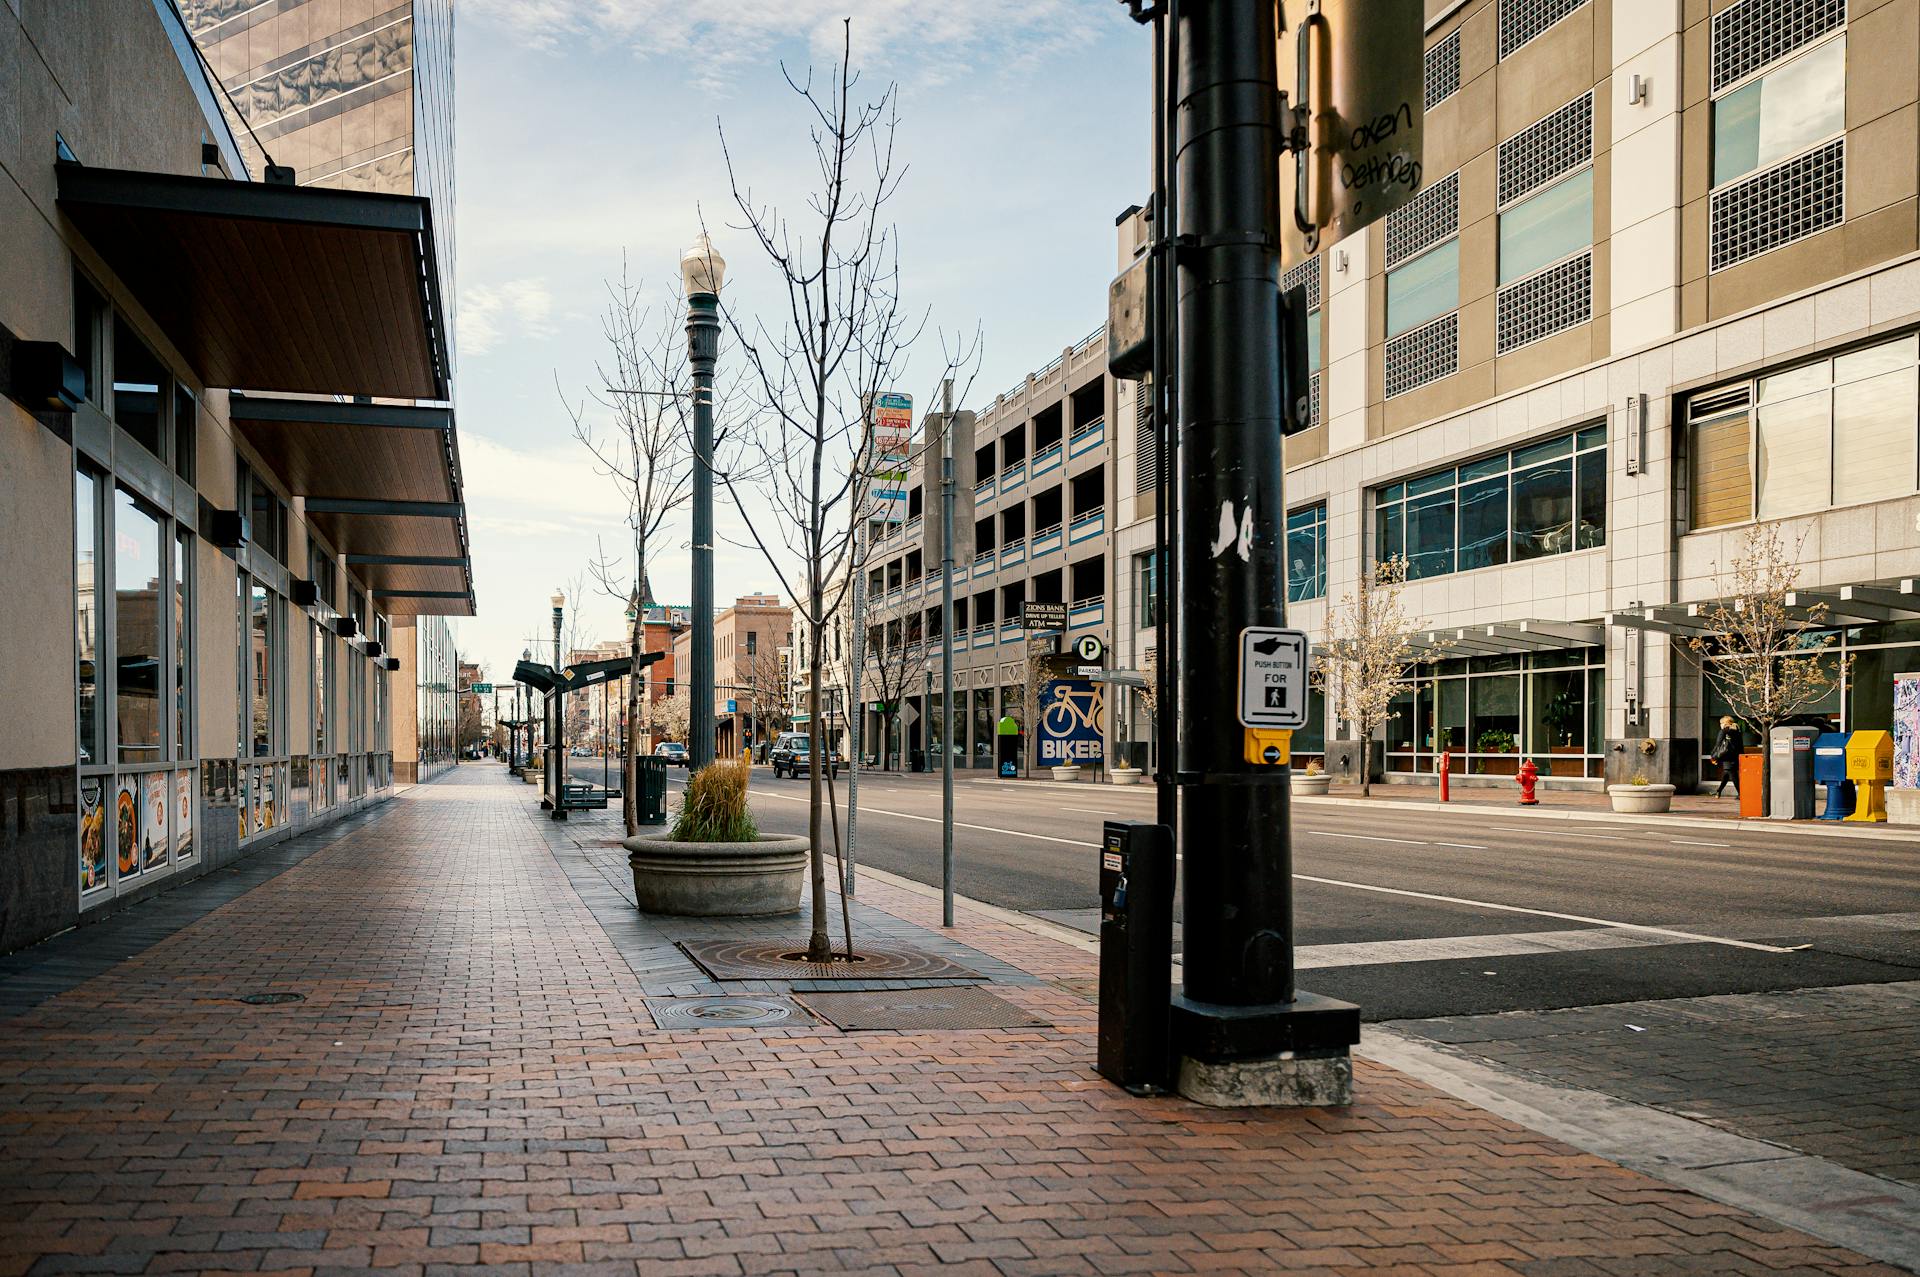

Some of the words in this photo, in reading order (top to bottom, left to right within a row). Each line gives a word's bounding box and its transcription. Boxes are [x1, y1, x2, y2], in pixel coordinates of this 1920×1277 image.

[1084, 640, 1096, 656] P
[1254, 660, 1271, 668] PUSH
[1272, 661, 1292, 669] BUTTON
[1264, 673, 1287, 683] FOR
